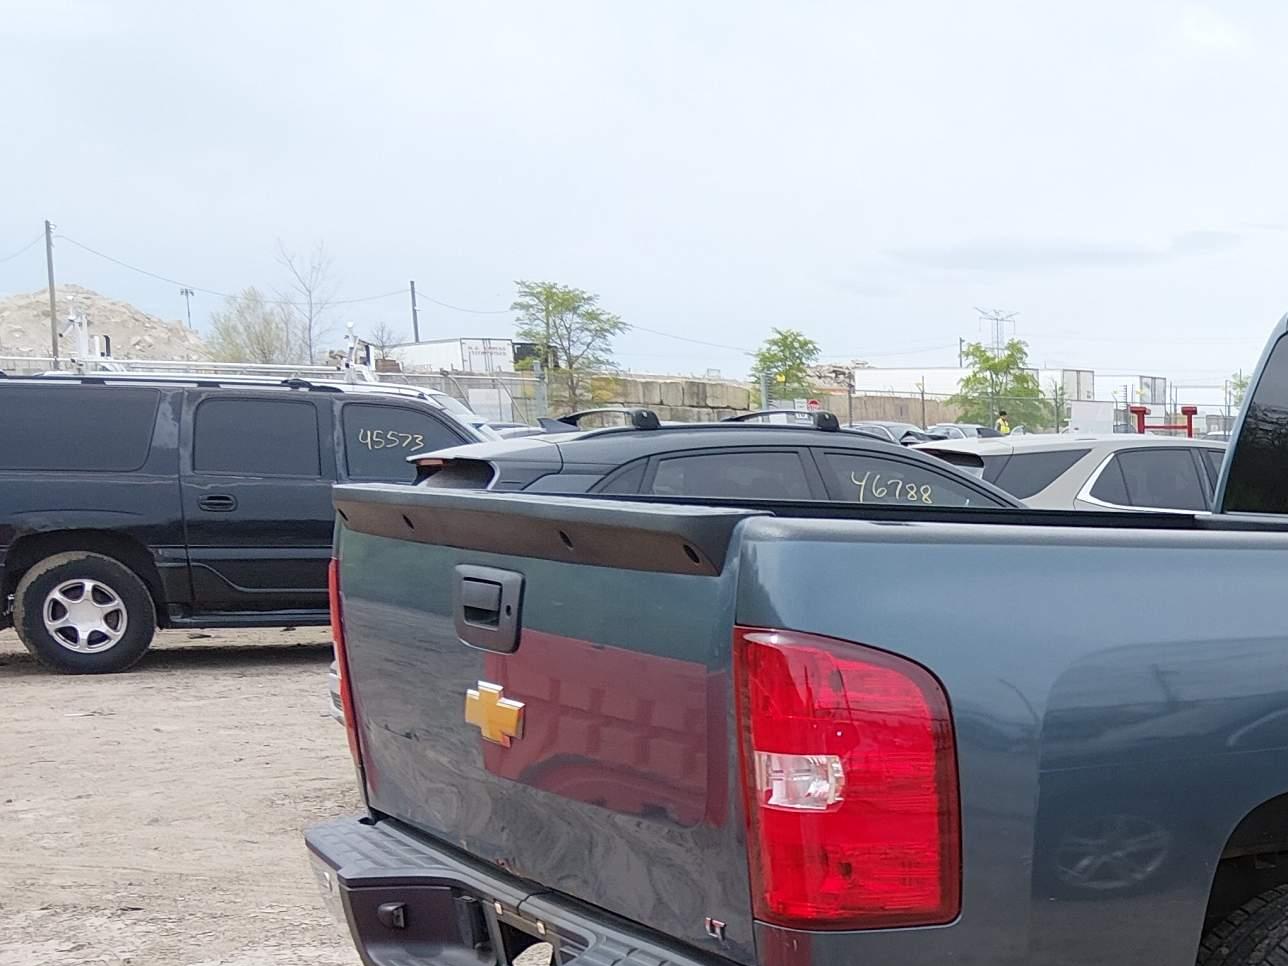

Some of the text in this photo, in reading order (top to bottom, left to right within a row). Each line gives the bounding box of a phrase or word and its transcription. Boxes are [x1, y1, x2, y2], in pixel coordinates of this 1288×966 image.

[358, 428, 425, 451] 45573
[851, 471, 933, 504] 46788
[704, 917, 725, 942] LT
